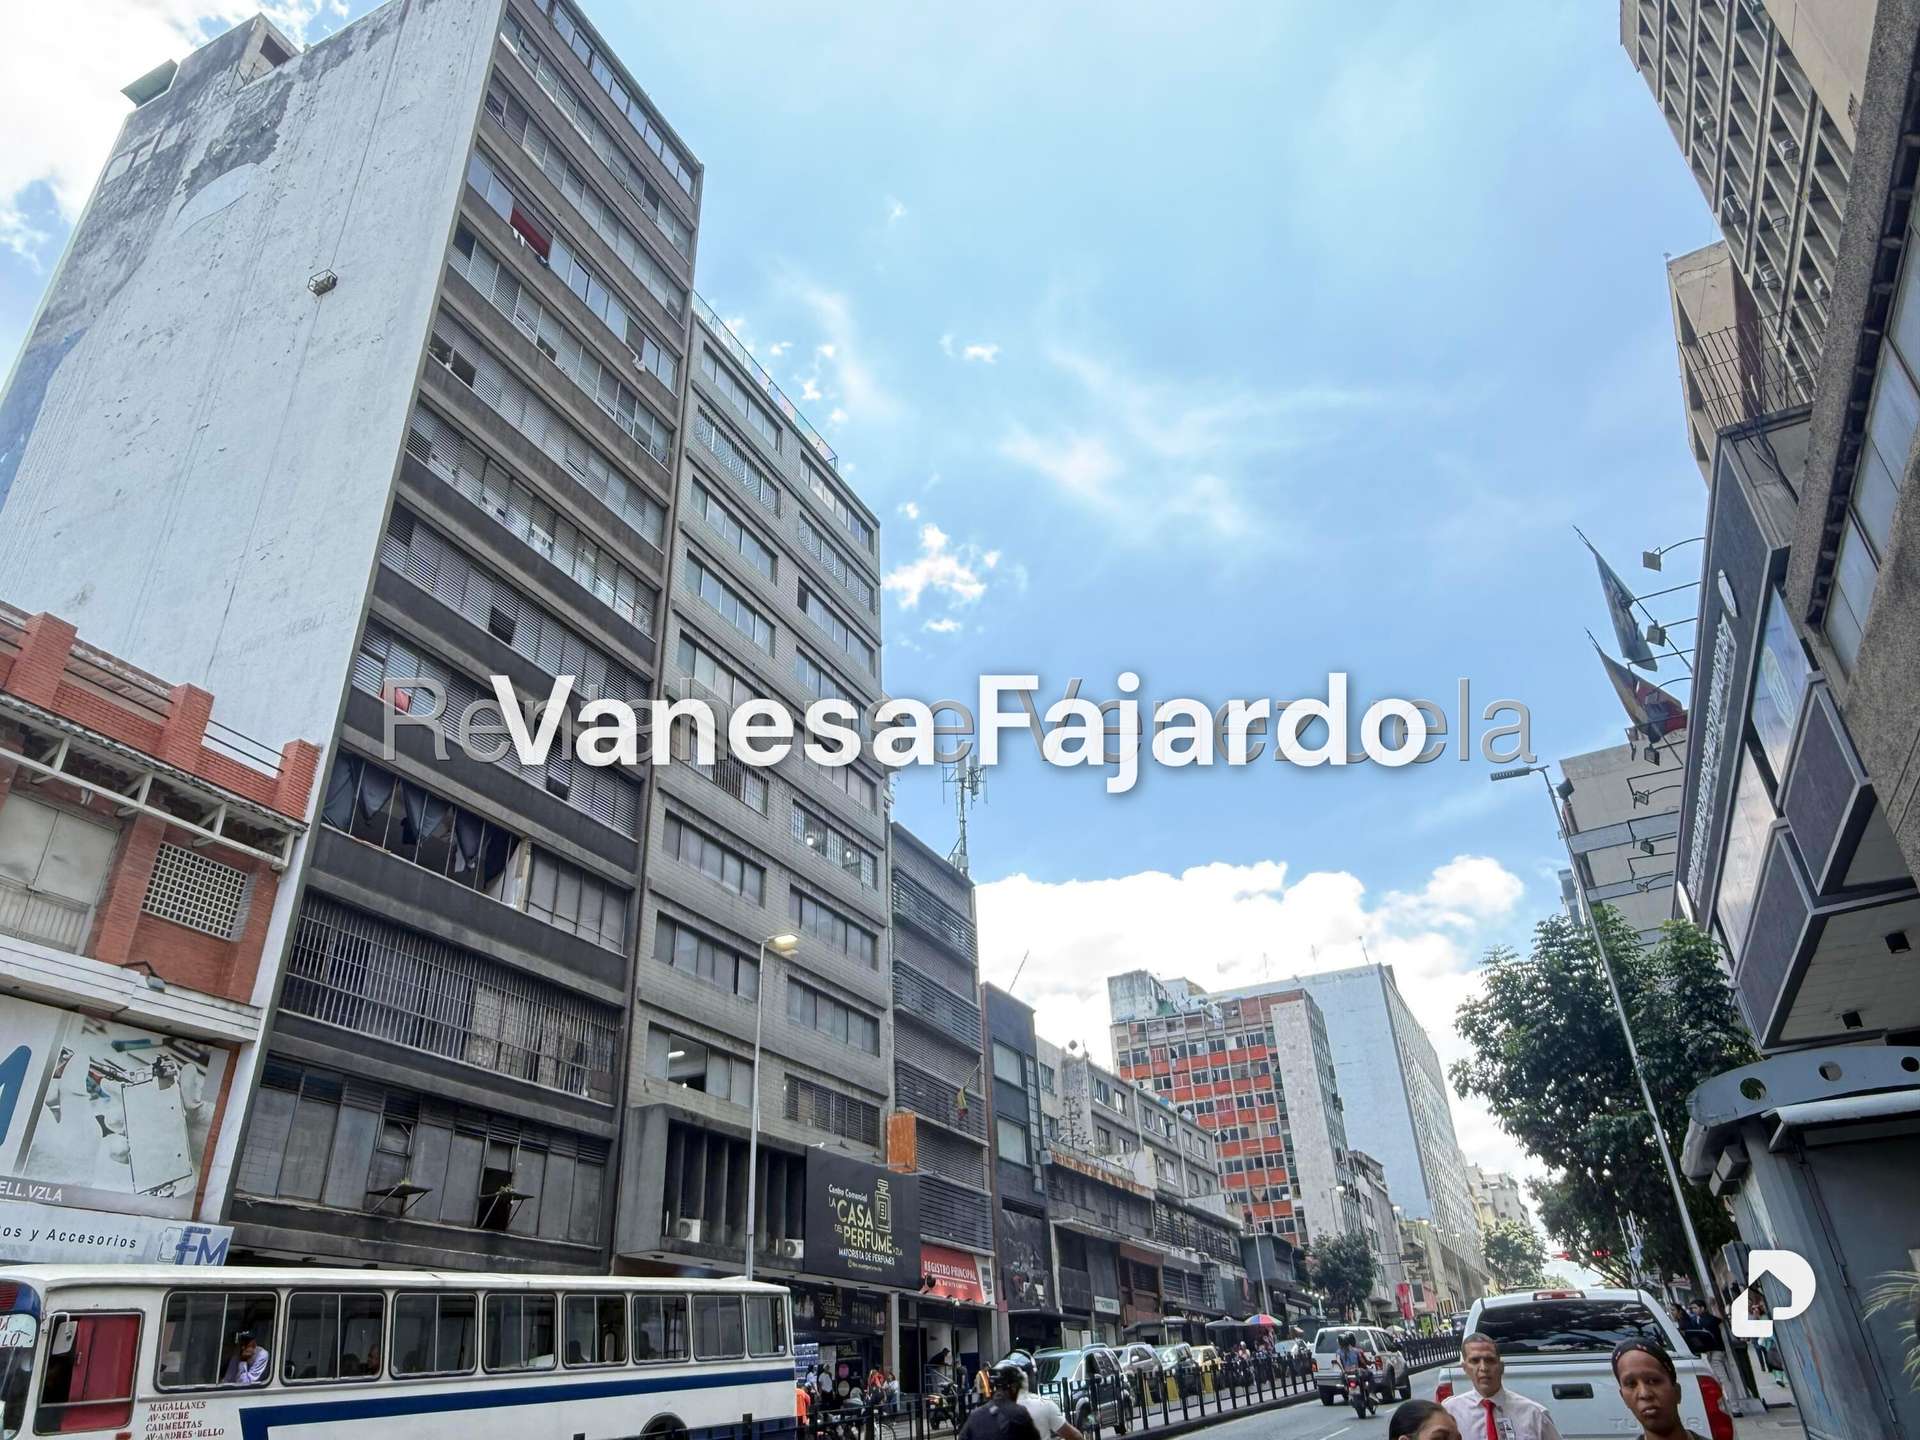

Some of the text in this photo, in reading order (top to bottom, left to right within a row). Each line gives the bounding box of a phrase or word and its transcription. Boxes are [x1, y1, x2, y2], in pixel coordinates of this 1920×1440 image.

[837, 1199, 874, 1230] CASA
[0, 1226, 138, 1249] os y Accesorios
[174, 1225, 230, 1267] FM
[843, 1225, 893, 1255] PERFUME
[924, 1260, 951, 1276] REGISTRO
[149, 1401, 206, 1411] MAGALLANES
[145, 1420, 202, 1431] CARMELITAS
